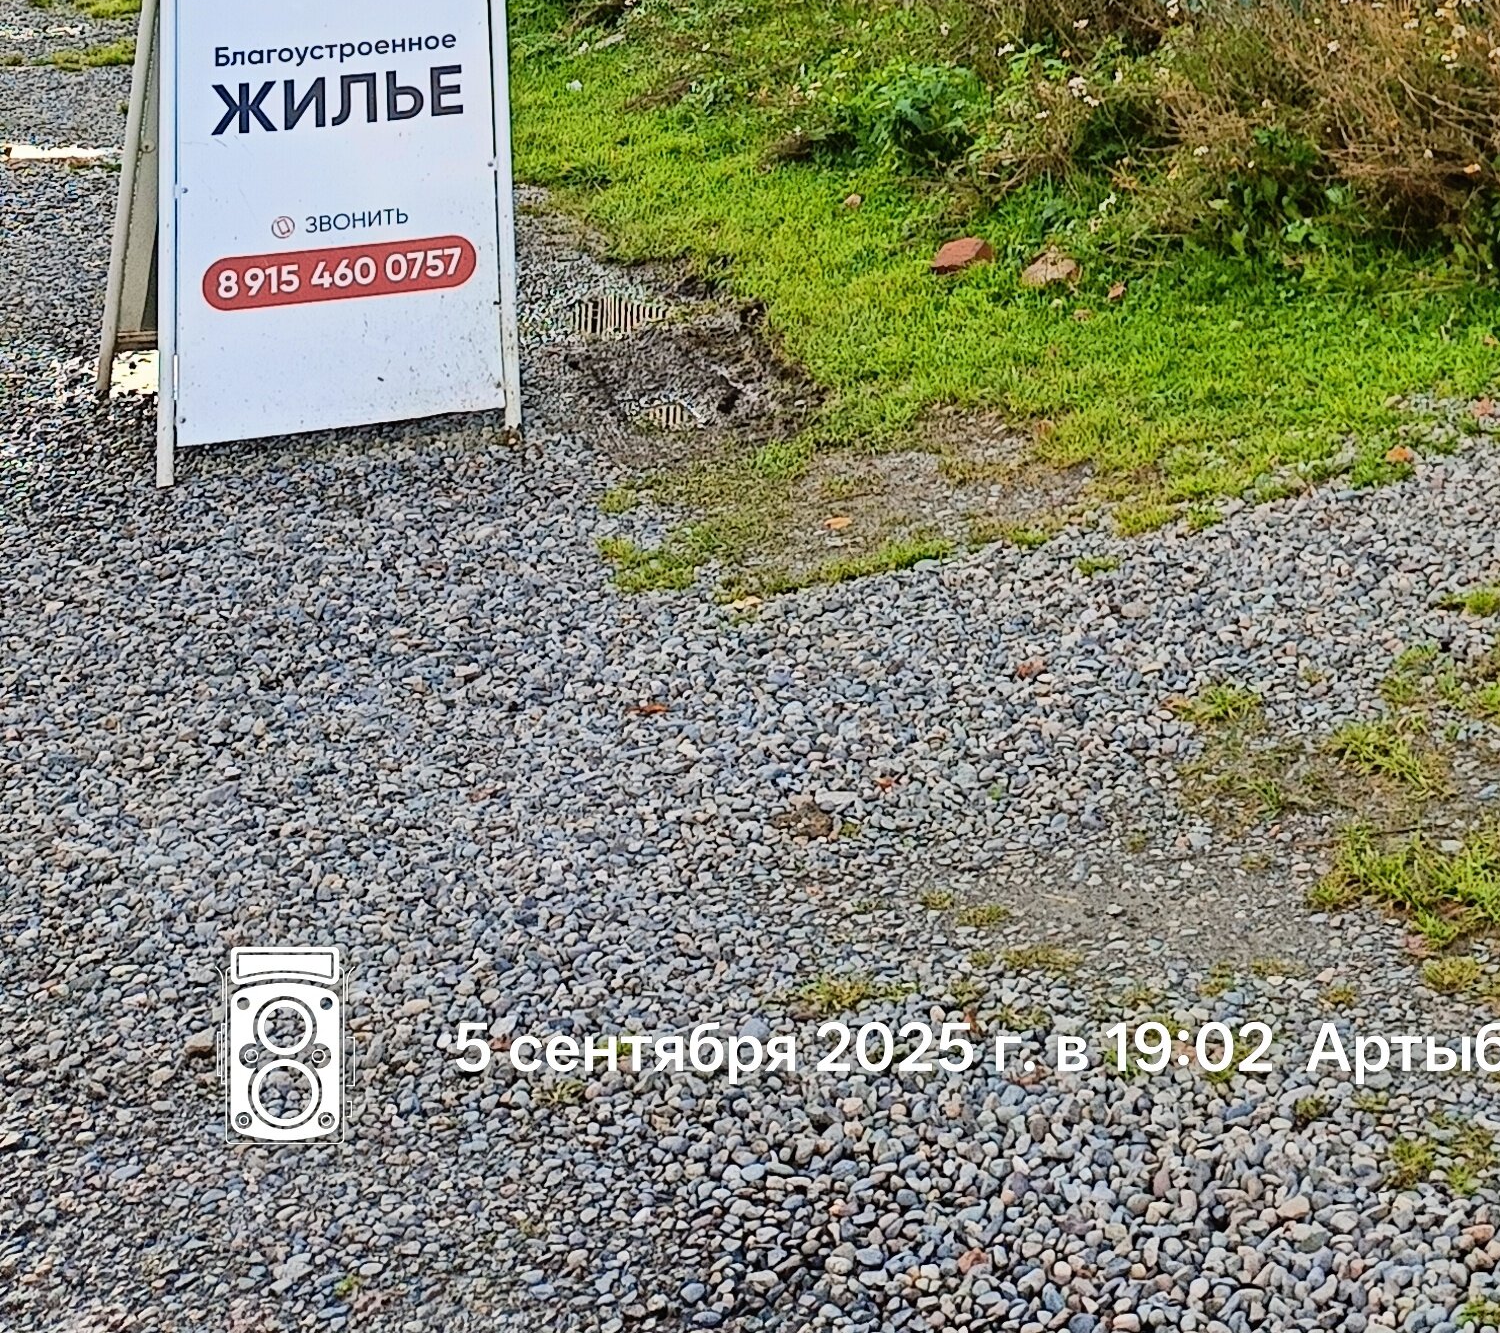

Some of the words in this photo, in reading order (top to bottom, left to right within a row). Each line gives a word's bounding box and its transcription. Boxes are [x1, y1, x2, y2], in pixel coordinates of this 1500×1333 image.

[214, 33, 457, 67] Благоустроенное
[211, 64, 464, 135] ЖИЛЬЕ
[305, 208, 409, 233] ЗВОНИТЬ
[217, 269, 239, 299] 8
[244, 264, 300, 296] 915
[310, 256, 377, 289] 460
[385, 247, 462, 282] 0757
